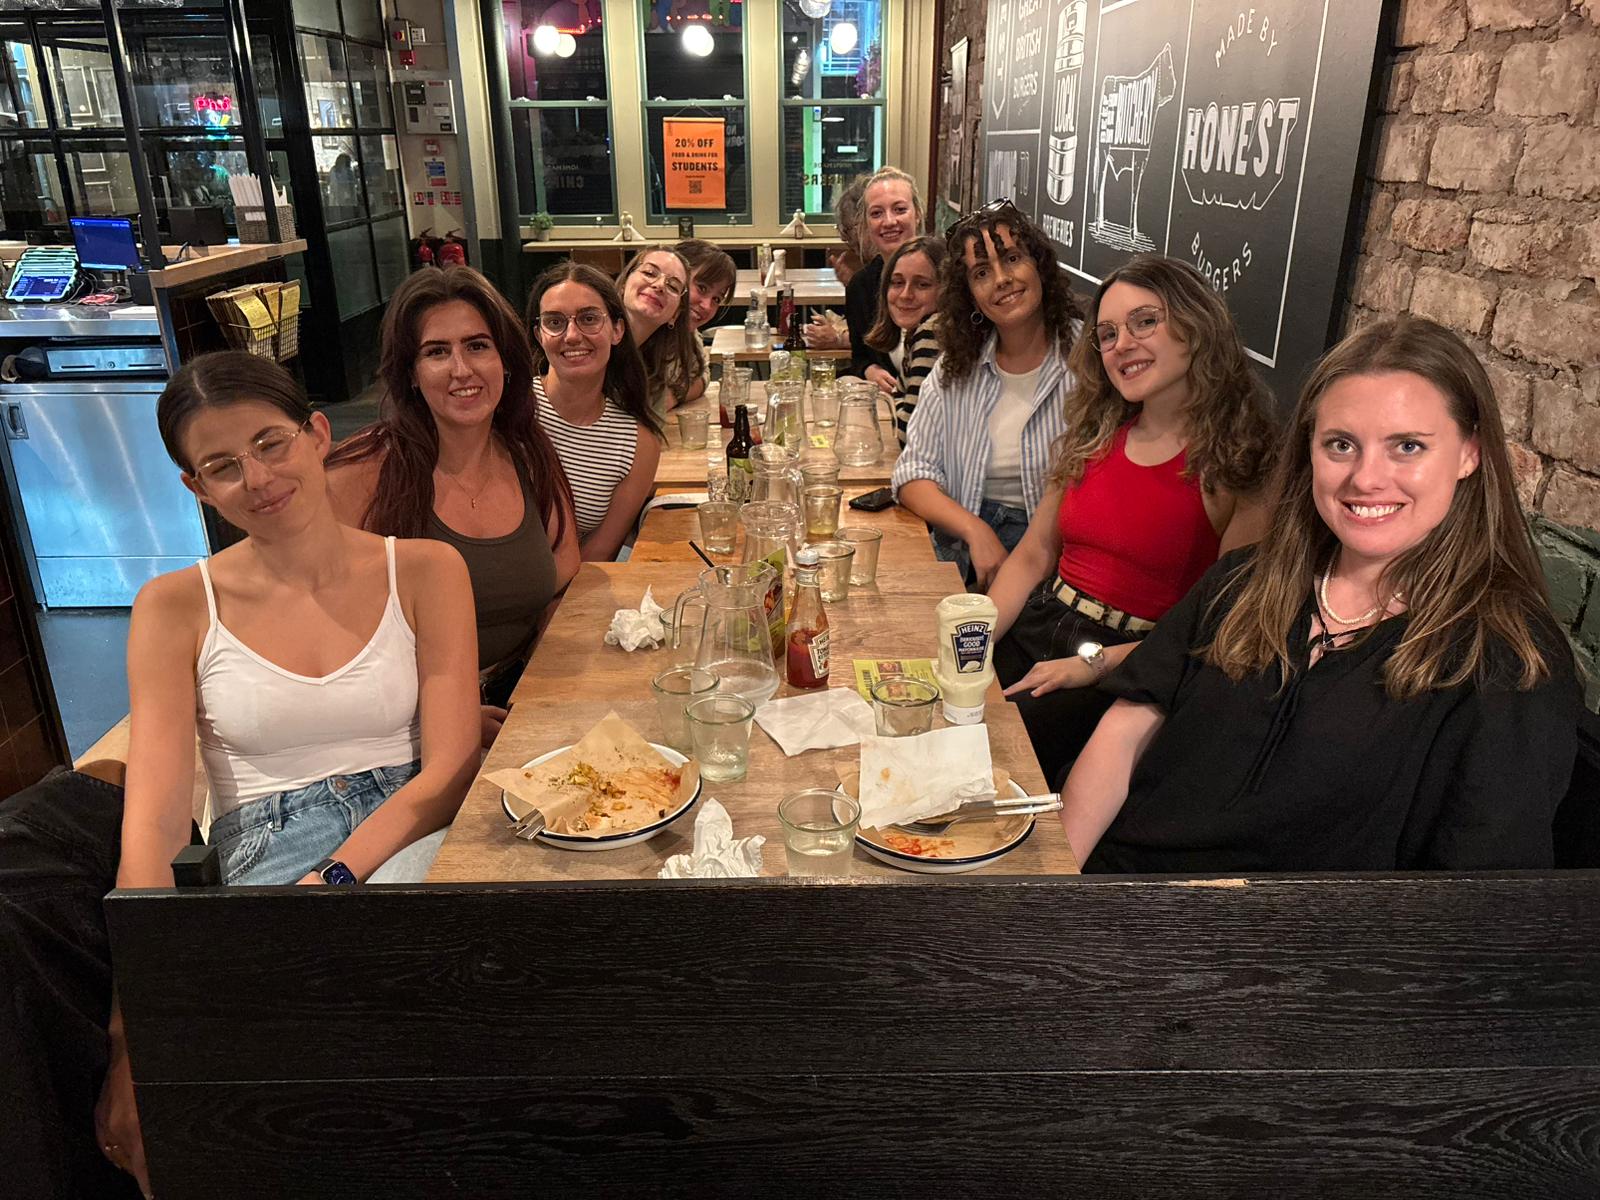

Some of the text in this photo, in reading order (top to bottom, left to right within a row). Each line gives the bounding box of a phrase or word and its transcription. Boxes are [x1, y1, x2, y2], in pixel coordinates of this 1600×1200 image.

[1015, 26, 1042, 62] BRITISH
[1215, 8, 1278, 68] MADE BY
[1054, 73, 1077, 134] LOCAL
[1114, 67, 1158, 146] BUTCHERY
[675, 138, 714, 148] 20% OFF
[1183, 99, 1299, 177] HONEST
[672, 161, 719, 172] STUDENTS
[1042, 213, 1074, 248] BREWERIES
[1191, 231, 1252, 292] BURGERS
[961, 625, 984, 634] HEINZ
